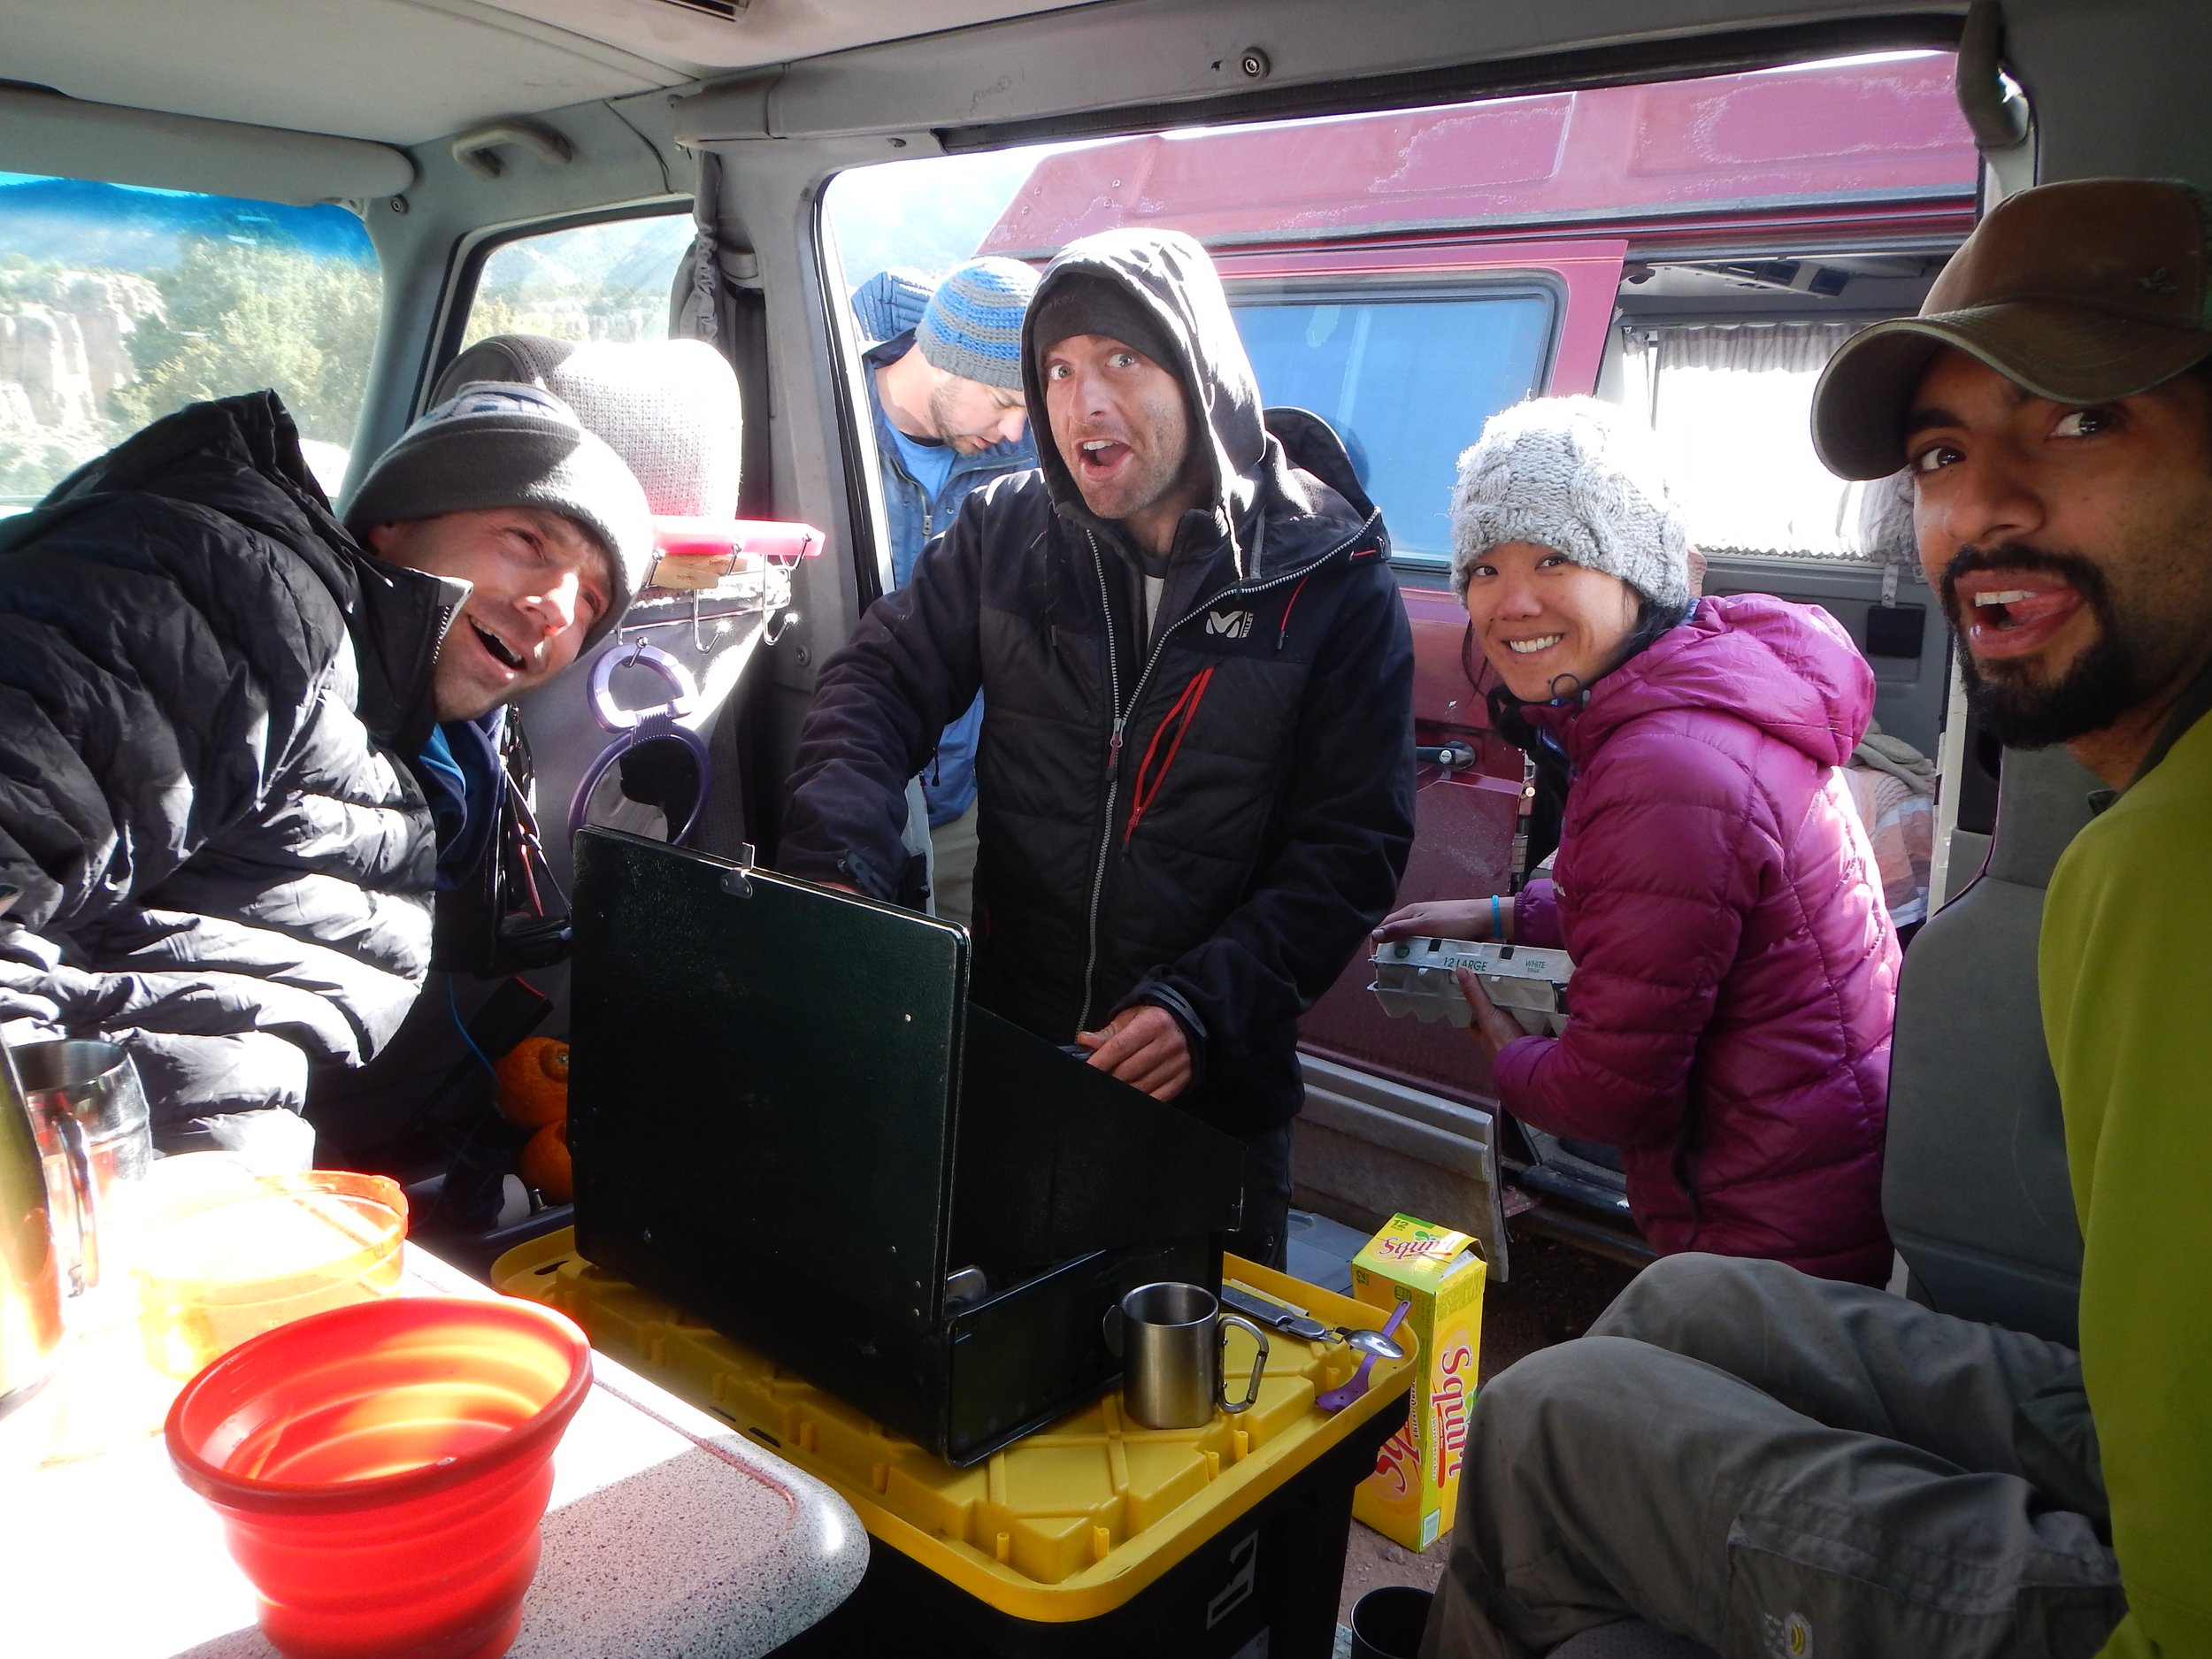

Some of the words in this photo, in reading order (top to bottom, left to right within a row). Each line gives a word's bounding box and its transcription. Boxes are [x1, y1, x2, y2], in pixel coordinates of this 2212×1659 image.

[1241, 612, 1254, 638] MILLET
[1443, 956, 1455, 968] 12
[1456, 958, 1488, 972] LARGE
[1525, 959, 1547, 969] WHITE
[1393, 1219, 1409, 1229] 12
[1356, 1271, 1366, 1285] 12
[1431, 1346, 1471, 1478] Squirt
[1410, 1409, 1419, 1438] Thirst
